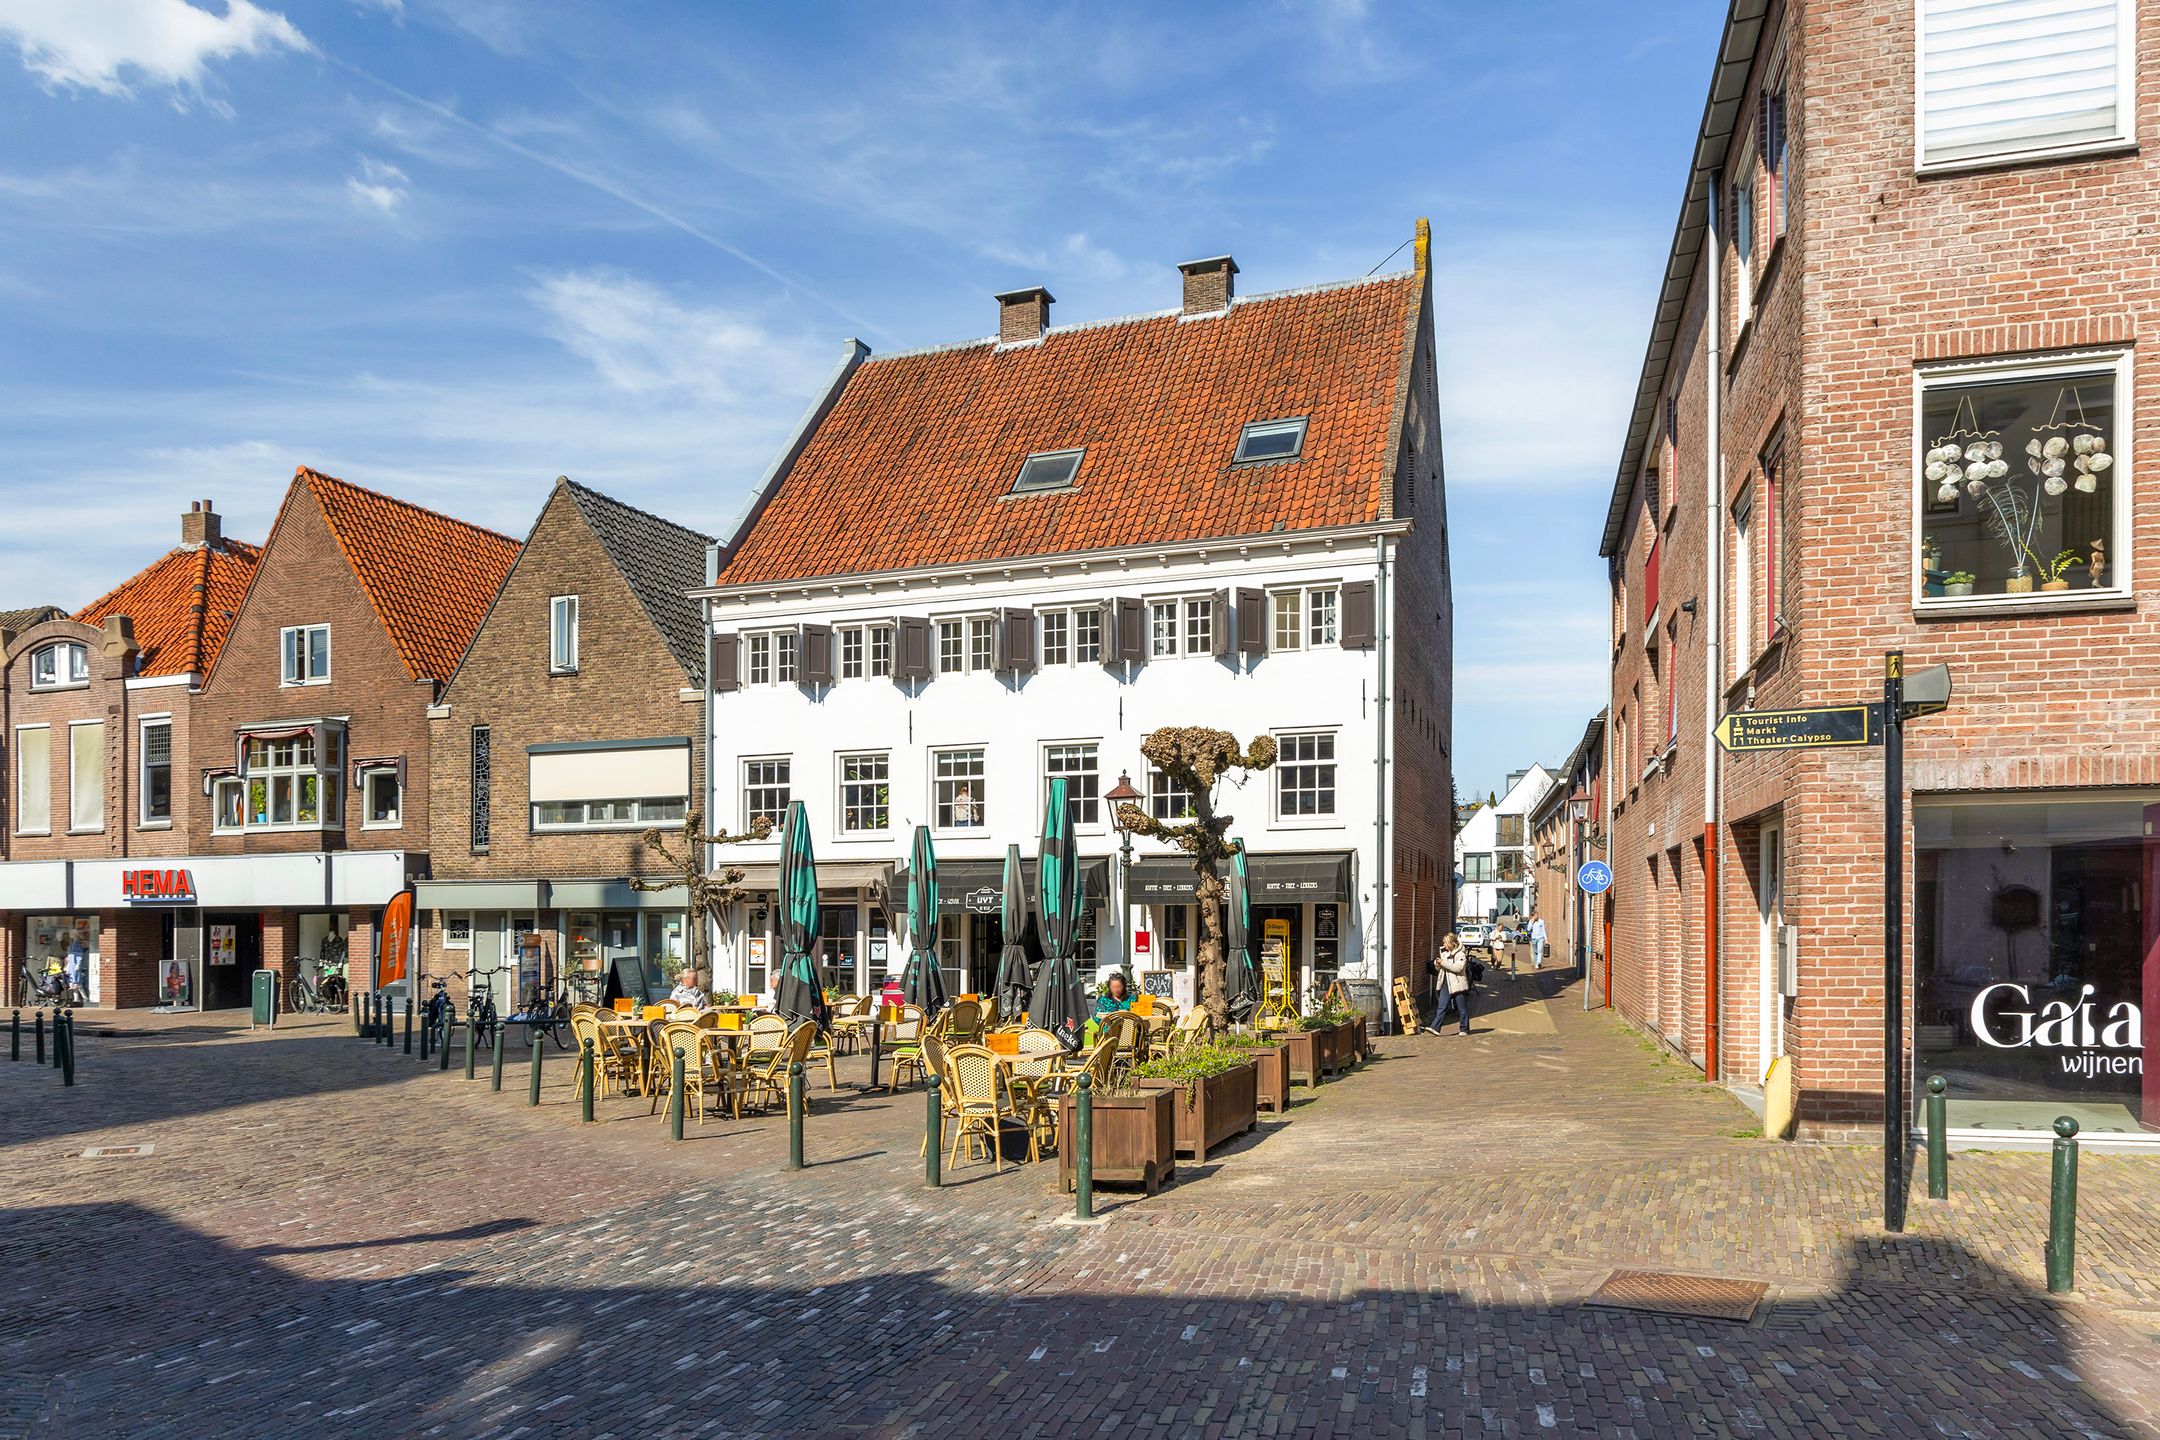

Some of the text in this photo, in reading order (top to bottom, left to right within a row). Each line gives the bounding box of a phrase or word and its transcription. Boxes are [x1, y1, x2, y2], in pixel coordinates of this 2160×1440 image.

[1746, 715, 1808, 725] Tourist Info
[1746, 726, 1777, 735] Markt
[1747, 734, 1832, 744] Theater Calypso
[122, 869, 191, 895] HEMA
[976, 896, 994, 904] UYT
[1970, 983, 2146, 1048] Gaia
[2061, 1051, 2143, 1078] wijnen
